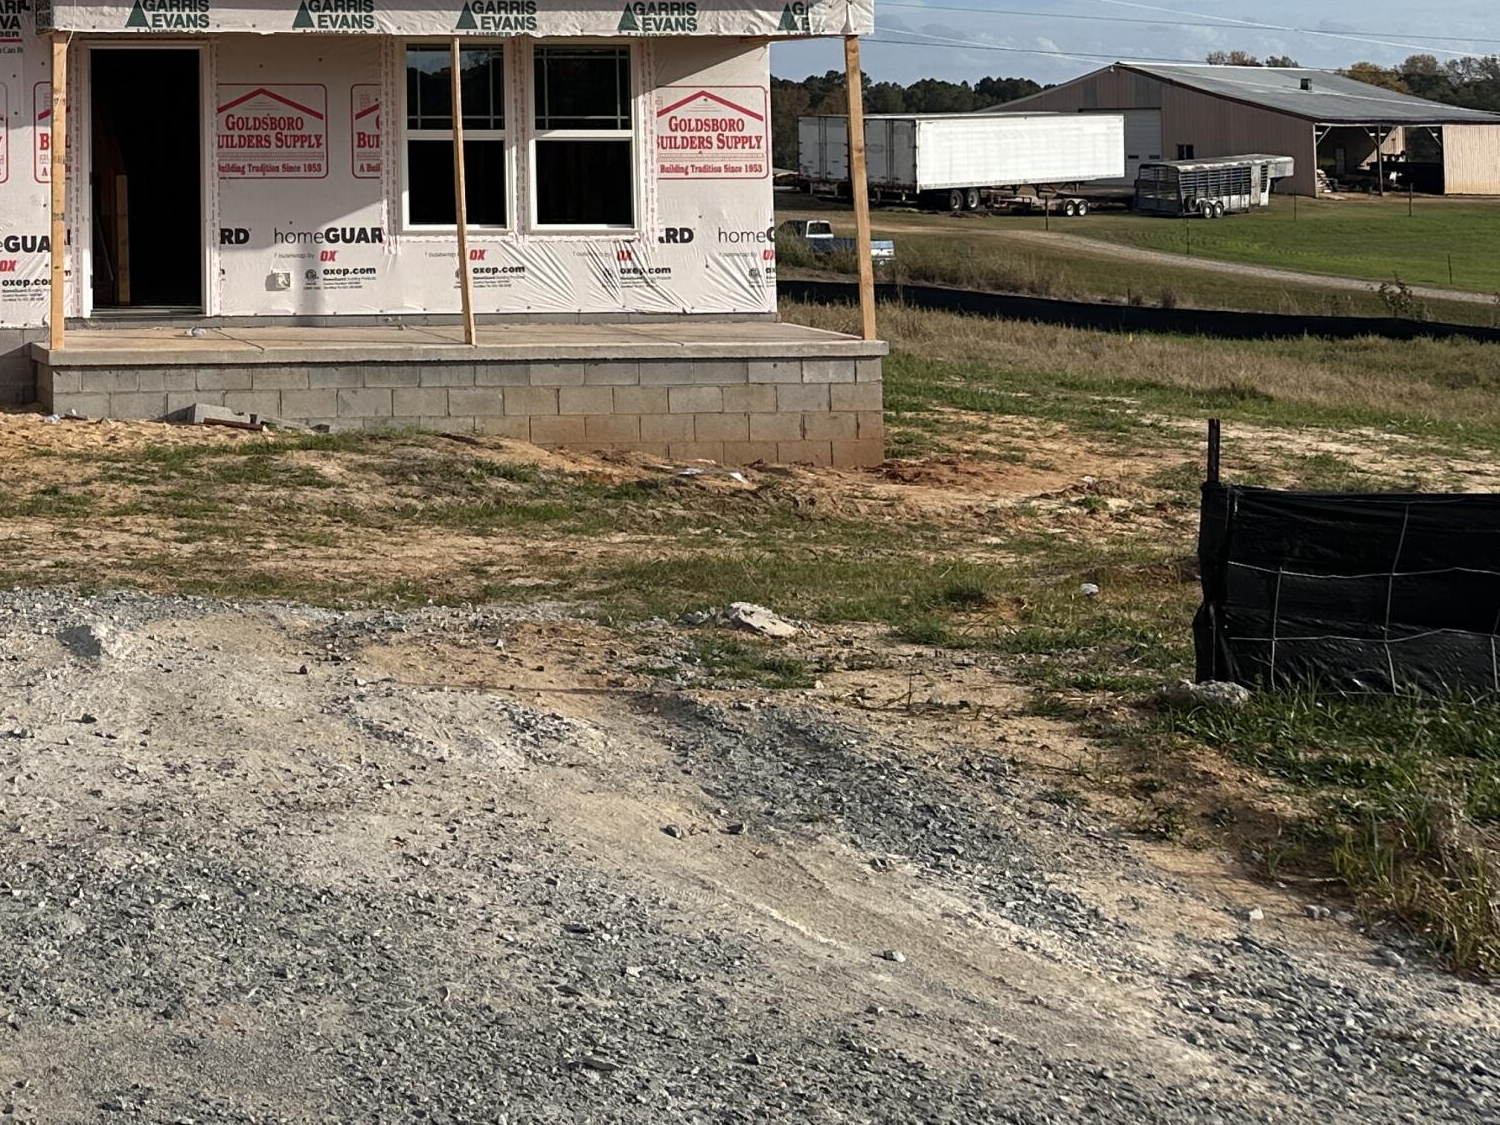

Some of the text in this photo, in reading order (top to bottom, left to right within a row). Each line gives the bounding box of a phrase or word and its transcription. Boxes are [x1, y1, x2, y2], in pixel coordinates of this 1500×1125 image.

[471, 0, 537, 15] GARRIS
[633, 1, 697, 16] GARRIS
[152, 13, 210, 28] EVANS
[318, 14, 375, 29] EVANS
[480, 16, 537, 30] EVANS
[642, 17, 698, 31] EVANS
[225, 114, 304, 131] GOLDSBORO
[668, 116, 745, 132] GOLDSBORO
[275, 132, 323, 149] SUPPLY
[716, 133, 763, 150] SUPPLY
[248, 163, 322, 174] Tradition Since 1953
[660, 164, 762, 175] Building Tradition Since 1953
[320, 250, 337, 262] OX
[469, 249, 486, 261] OX
[0, 260, 17, 272] OX
[323, 266, 376, 276] oxep.com
[472, 266, 526, 275] oxep.com
[620, 267, 671, 276] oxepcom
